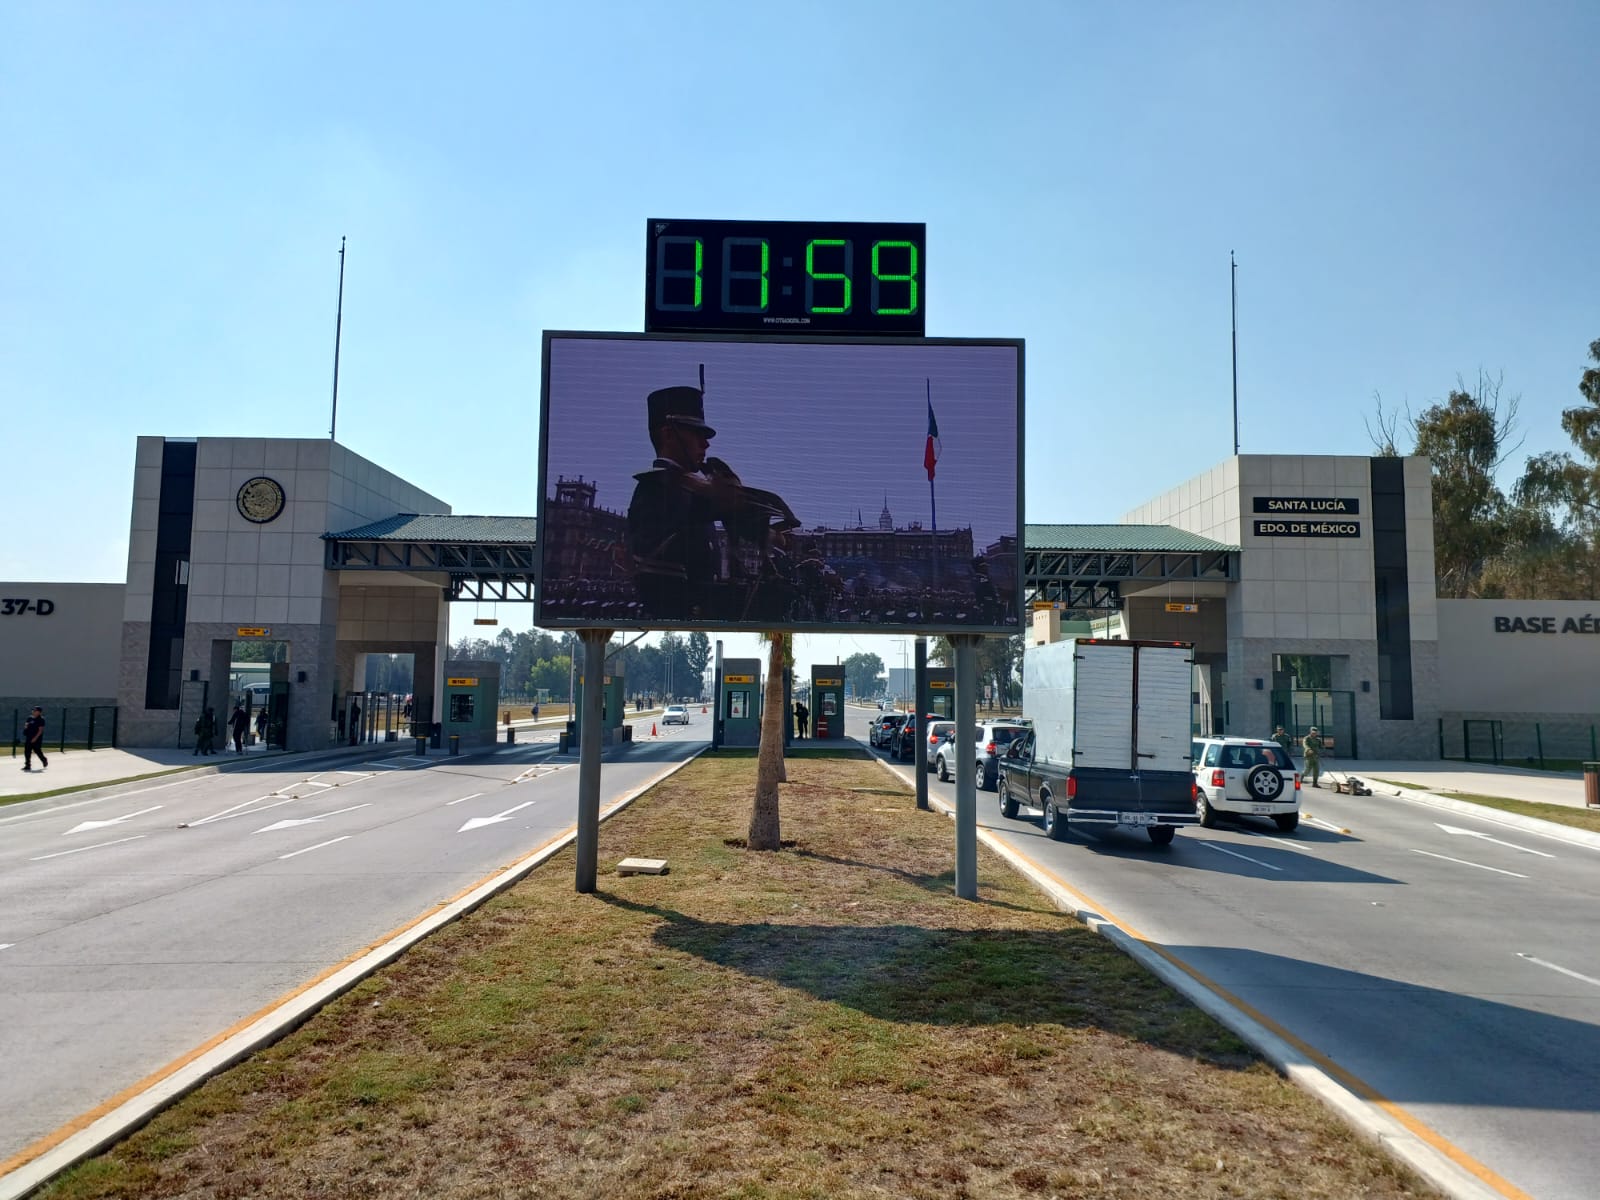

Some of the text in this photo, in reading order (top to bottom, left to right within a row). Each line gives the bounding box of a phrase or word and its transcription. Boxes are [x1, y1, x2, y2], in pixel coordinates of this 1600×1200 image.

[1268, 498, 1346, 511] SANTA LUCÍA
[1260, 522, 1357, 534] EDO. DE MÉXICO
[0, 599, 54, 615] 37-D
[1494, 616, 1557, 633] BASE
